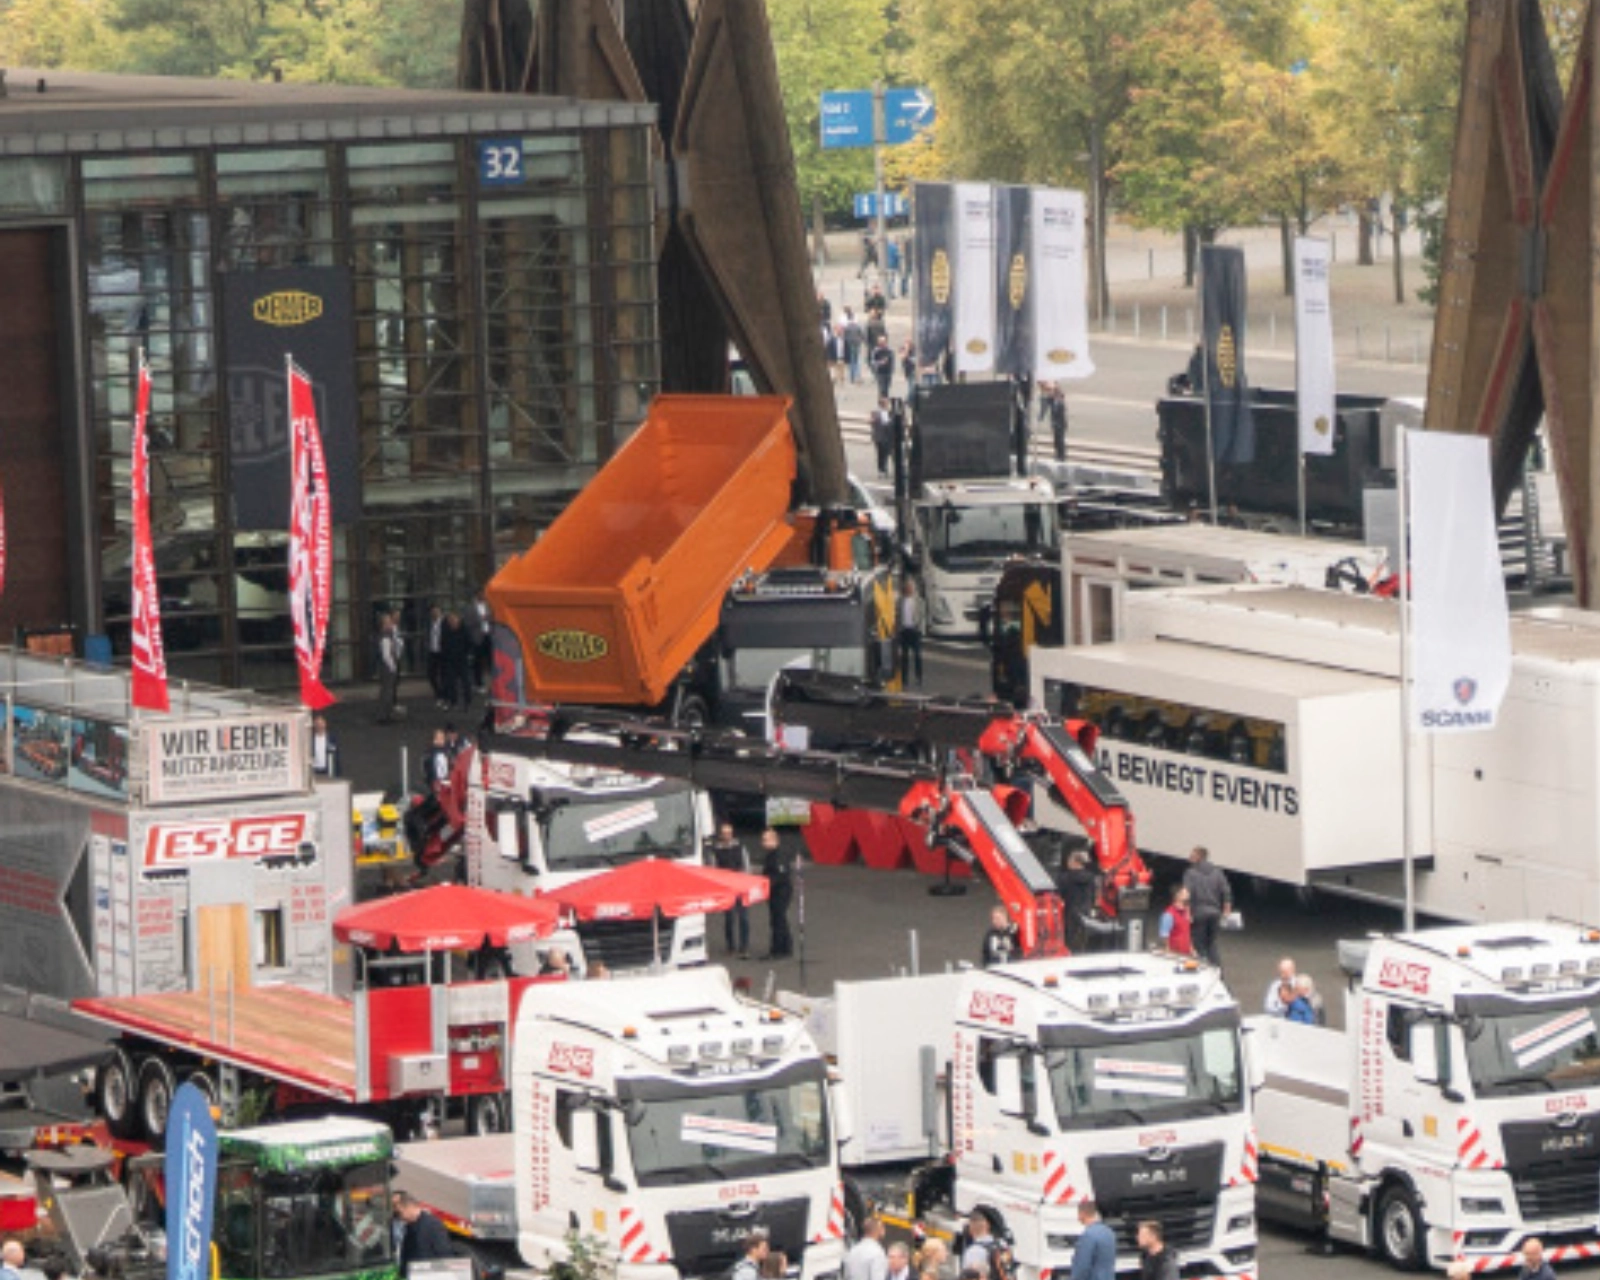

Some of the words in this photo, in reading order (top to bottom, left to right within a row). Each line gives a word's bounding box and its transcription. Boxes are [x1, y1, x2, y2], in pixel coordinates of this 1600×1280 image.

[486, 146, 519, 178] 32
[162, 728, 209, 757] WIR
[162, 749, 288, 778] NUTZFAHRZEUGE
[1118, 753, 1207, 796] BEWEGT
[1213, 772, 1299, 816] EVENTS
[1132, 1168, 1188, 1186] MAN
